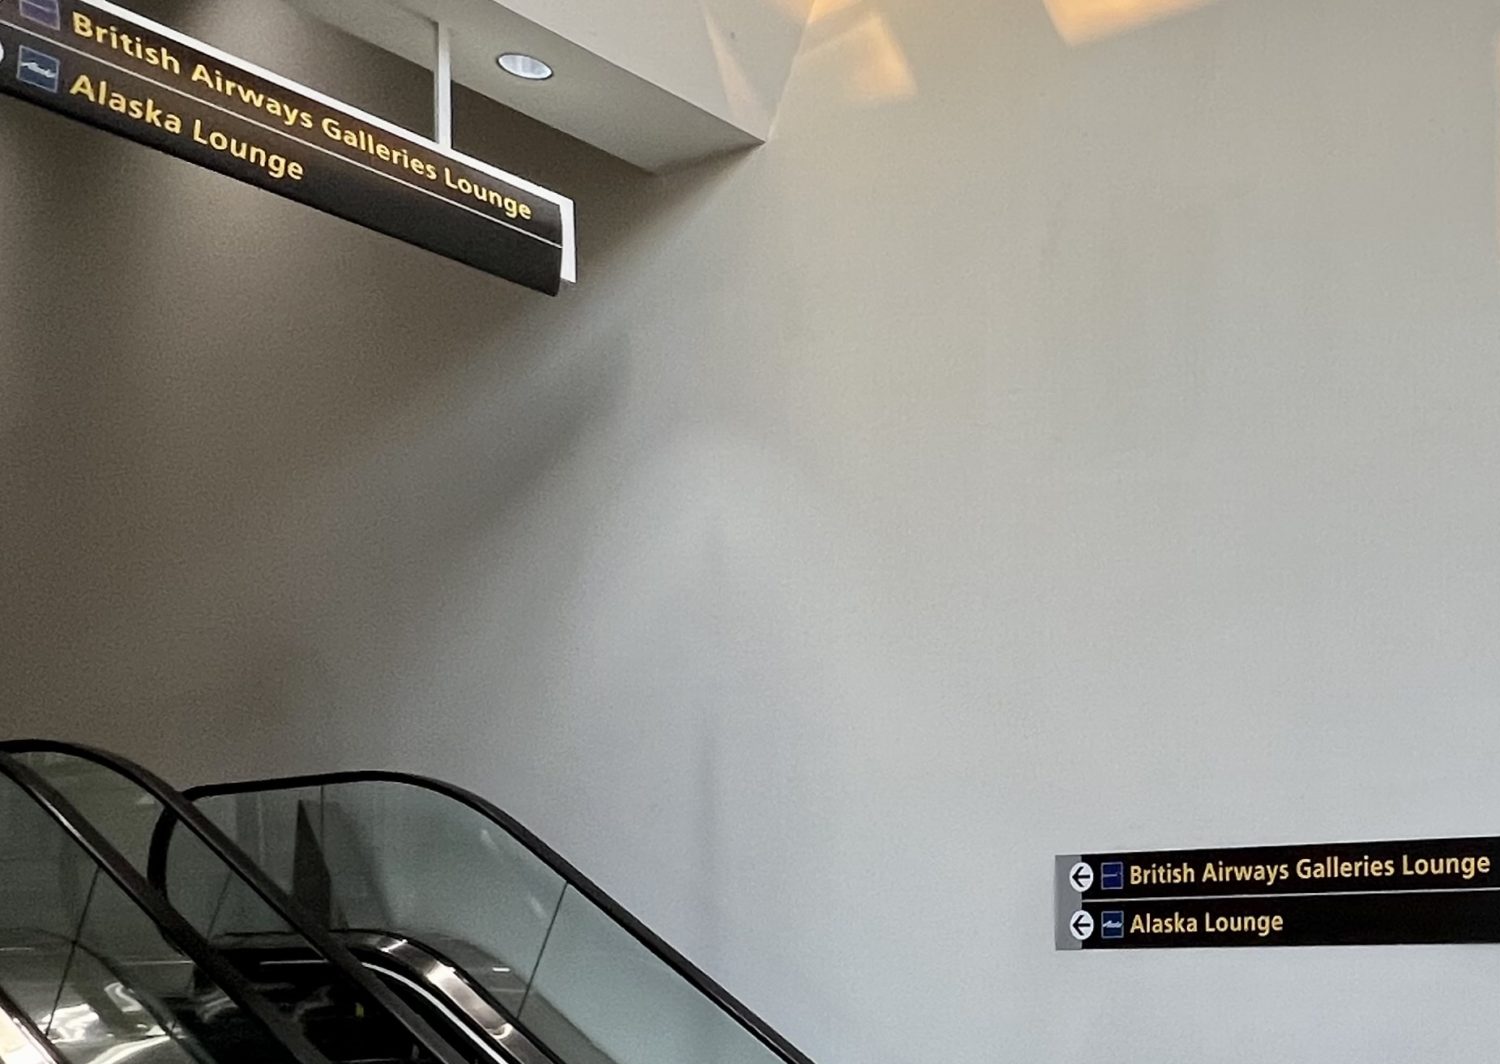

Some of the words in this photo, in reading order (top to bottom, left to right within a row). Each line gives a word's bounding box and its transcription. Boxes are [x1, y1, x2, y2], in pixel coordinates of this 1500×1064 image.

[70, 74, 183, 134] Alaska
[193, 119, 304, 180] Lounge
[72, 11, 181, 75] British
[191, 63, 313, 129] Airways
[321, 118, 437, 180] Galleries
[444, 167, 532, 219] Lounge
[1129, 862, 1195, 885] British
[1202, 861, 1289, 886] Airways
[1296, 855, 1395, 879] Galleries
[1402, 854, 1491, 880] Lounge
[1129, 912, 1198, 933] Alaska
[1205, 912, 1283, 937] Lounge
